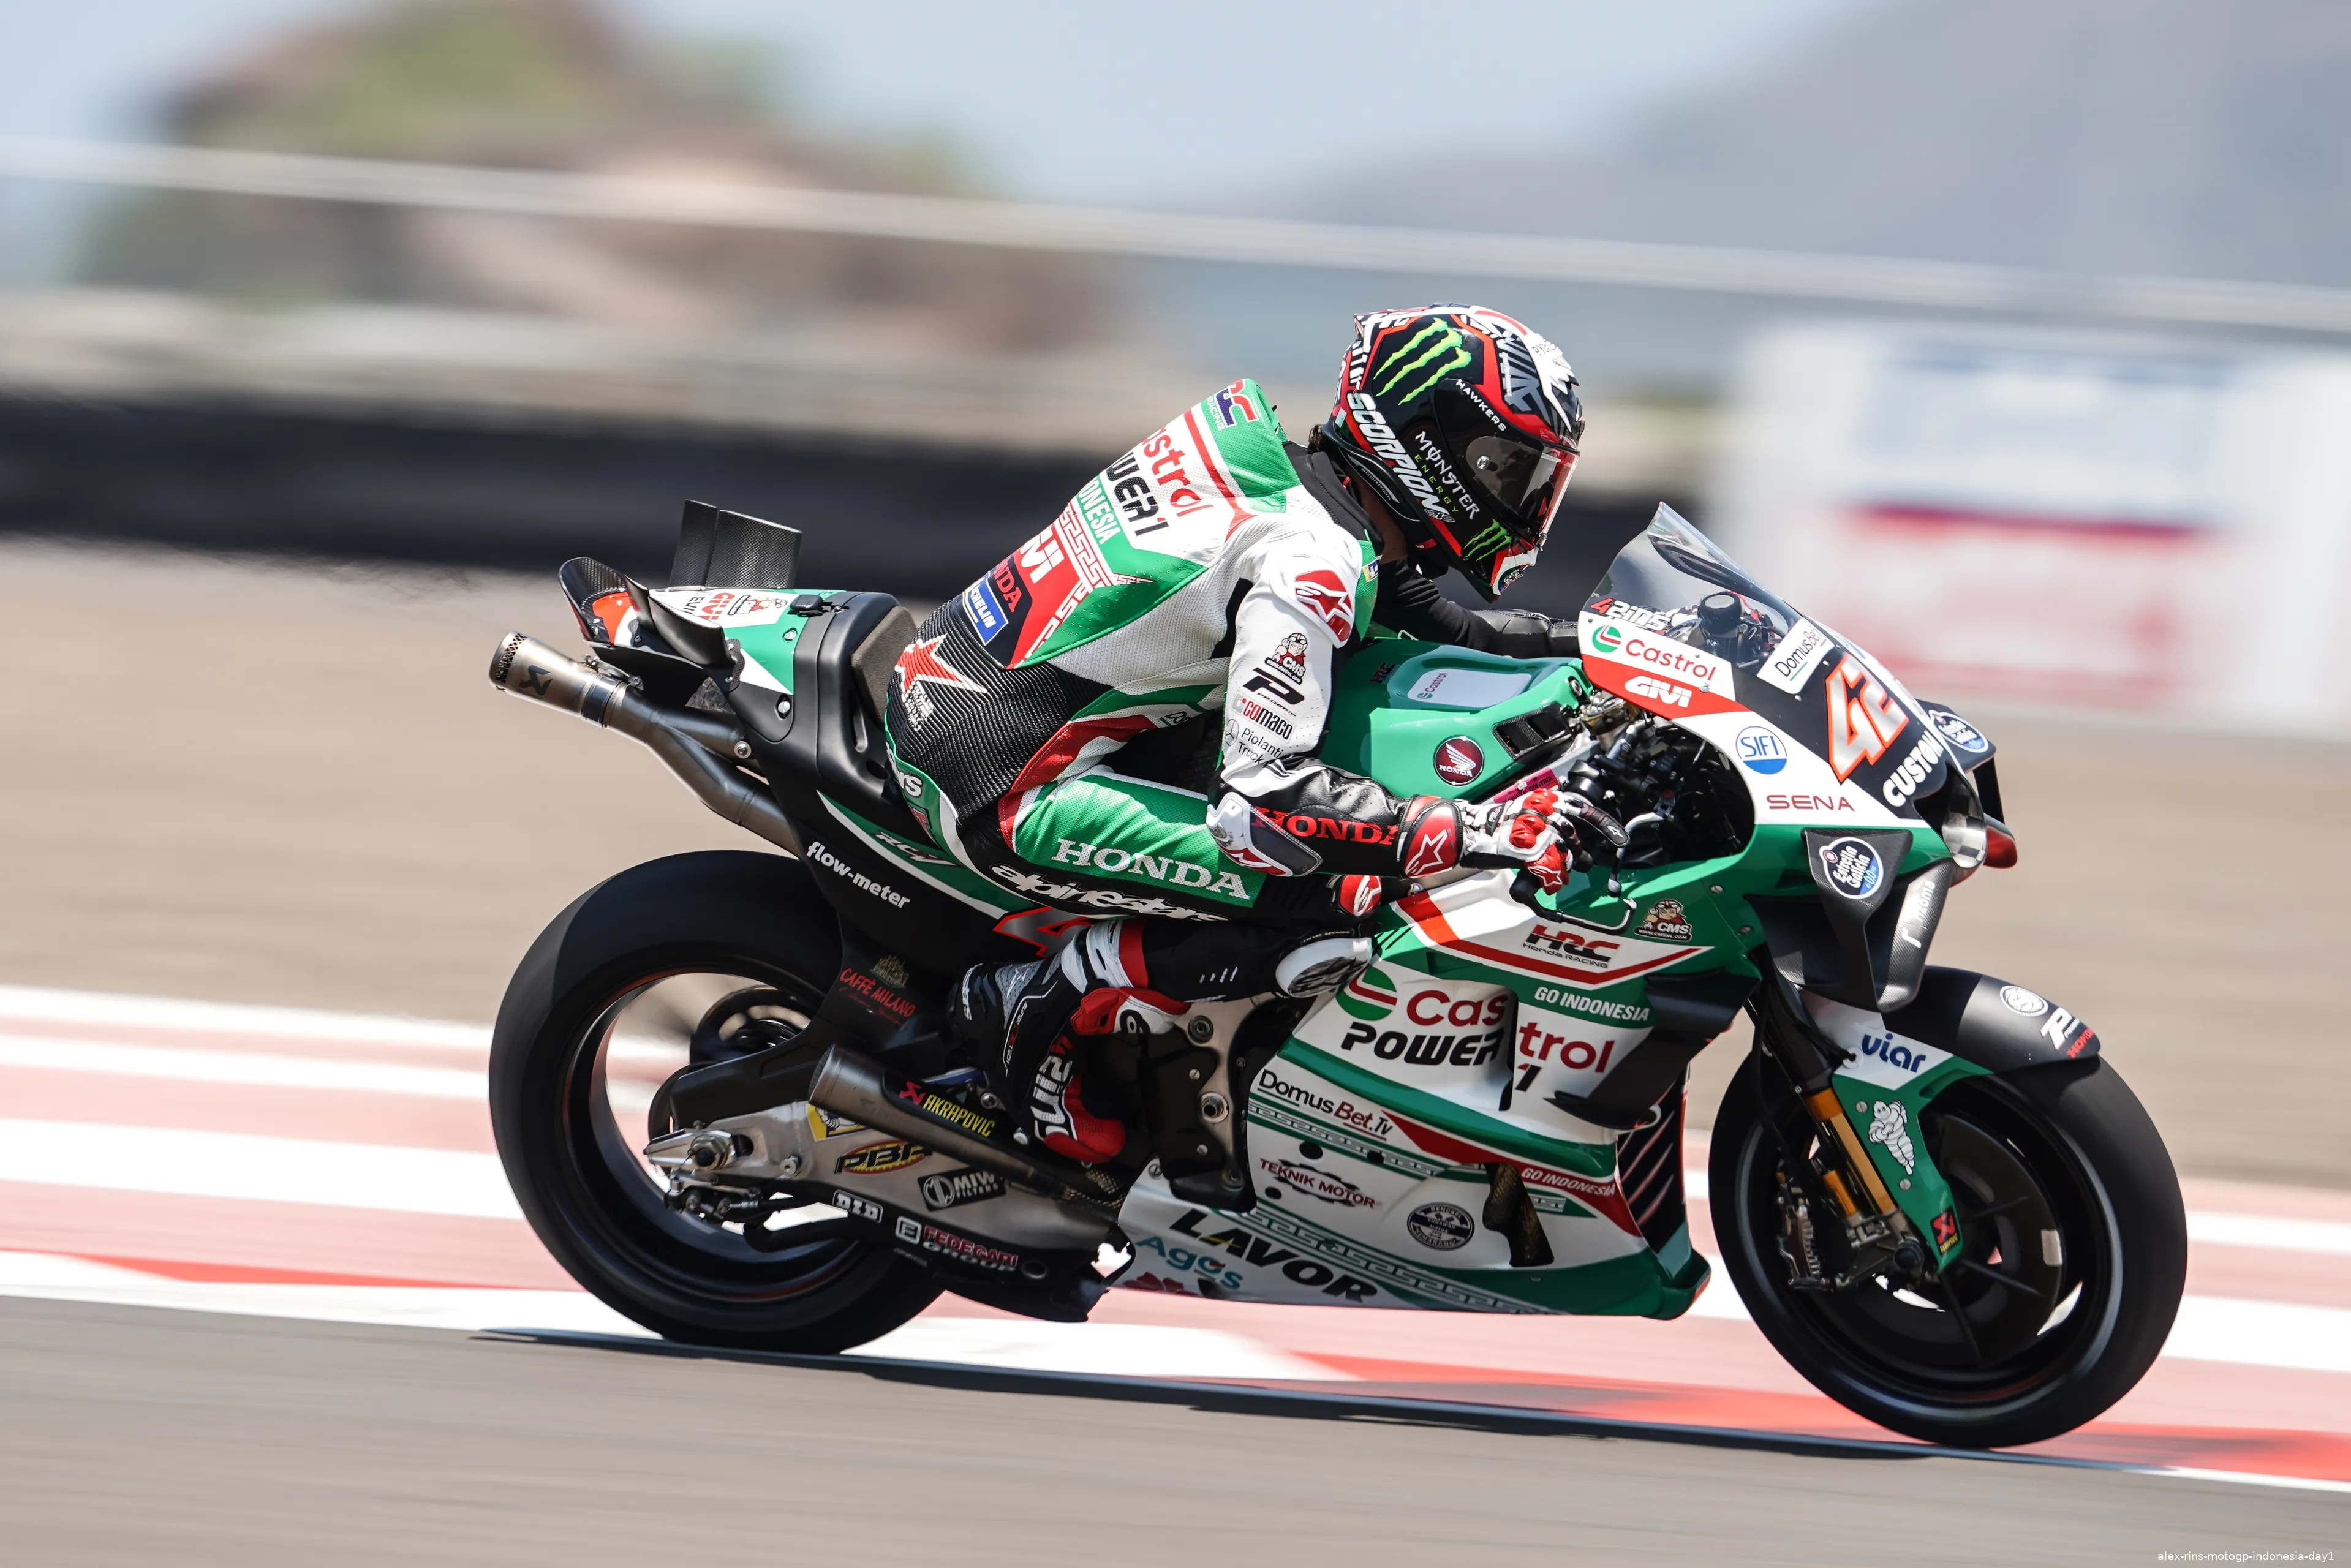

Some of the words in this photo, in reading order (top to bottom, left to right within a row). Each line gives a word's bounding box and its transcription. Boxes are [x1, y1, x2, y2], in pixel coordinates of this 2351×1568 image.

[1455, 378, 1507, 432] HAWKERS
[1142, 428, 1213, 518] strol
[1348, 392, 1449, 518] SCORPION
[1105, 451, 1169, 537] WER1
[1360, 467, 1392, 500] SCORPION
[1414, 454, 1459, 513] ENERGY
[1079, 477, 1121, 545] ONESIA
[994, 558, 1022, 612] NDA
[1283, 656, 1307, 677] CMS
[1626, 639, 1717, 681] Castrol
[1425, 672, 1448, 693] Castrol
[1624, 675, 1692, 708] GIVI
[1242, 700, 1294, 741] comaco
[1825, 651, 1910, 784] 42
[1238, 741, 1265, 764] Truck
[1241, 728, 1285, 759] Piolanti
[1740, 734, 1780, 758] SIFI
[1439, 764, 1473, 778] HONDA
[1882, 729, 1945, 808] CUSTOM
[1766, 794, 1855, 812] SENA
[806, 841, 911, 909] flow-meter
[1051, 837, 1251, 900] HONDA
[1832, 846, 1858, 884] Estrella
[1846, 854, 1871, 888] Galicia
[991, 863, 1229, 921] alpinestars
[1525, 924, 1621, 963] HRC
[1657, 922, 1689, 935] CMS
[1522, 942, 1563, 959] Honda
[1564, 954, 1609, 970] RACING
[839, 968, 877, 996] CAFFÈ
[870, 986, 916, 1018] MILANO
[1534, 986, 1560, 1004] GO
[1560, 992, 1650, 1022] INDONESIA
[1861, 1033, 1926, 1073] viar
[2066, 1027, 2096, 1060] HOND
[922, 1093, 997, 1137] AKRAPOVIC
[953, 1170, 995, 1189] MIW
[1259, 1158, 1316, 1188] TEKNIK
[1318, 1180, 1376, 1209] MOTOR
[1520, 1167, 1544, 1181] GO
[1542, 1173, 1616, 1196] INDONESIA
[922, 1240, 1016, 1272] GROUP
[923, 1225, 1018, 1268] FEDEGARI
[1135, 1235, 1244, 1290] Agos
[1169, 1208, 1378, 1303] LAVOR
